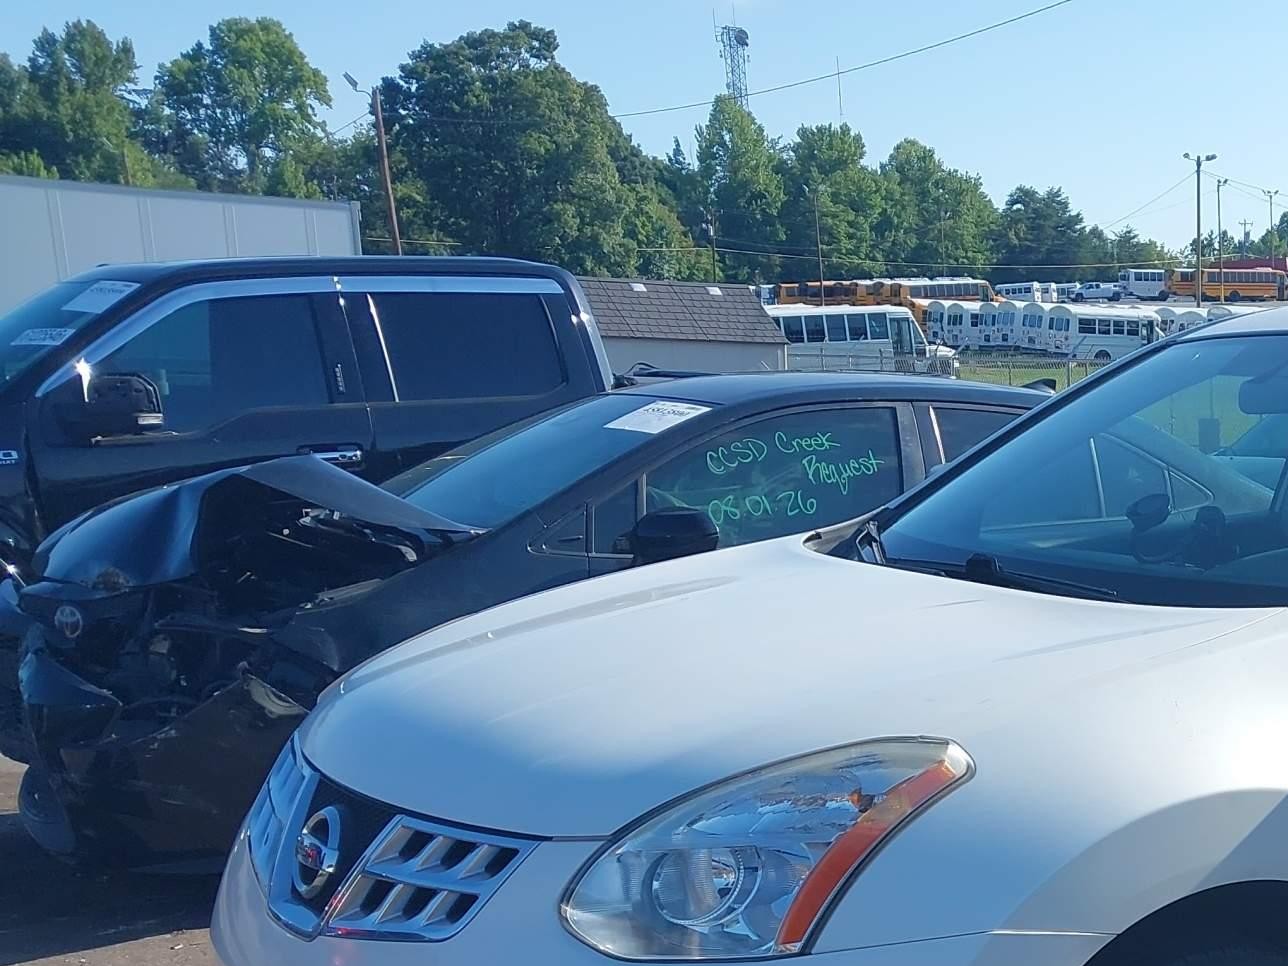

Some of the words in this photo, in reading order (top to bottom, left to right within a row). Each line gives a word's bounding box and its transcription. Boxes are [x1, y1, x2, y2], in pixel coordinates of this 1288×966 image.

[706, 438, 767, 474] CCSD
[775, 431, 840, 453] Creek
[802, 449, 885, 495] Request
